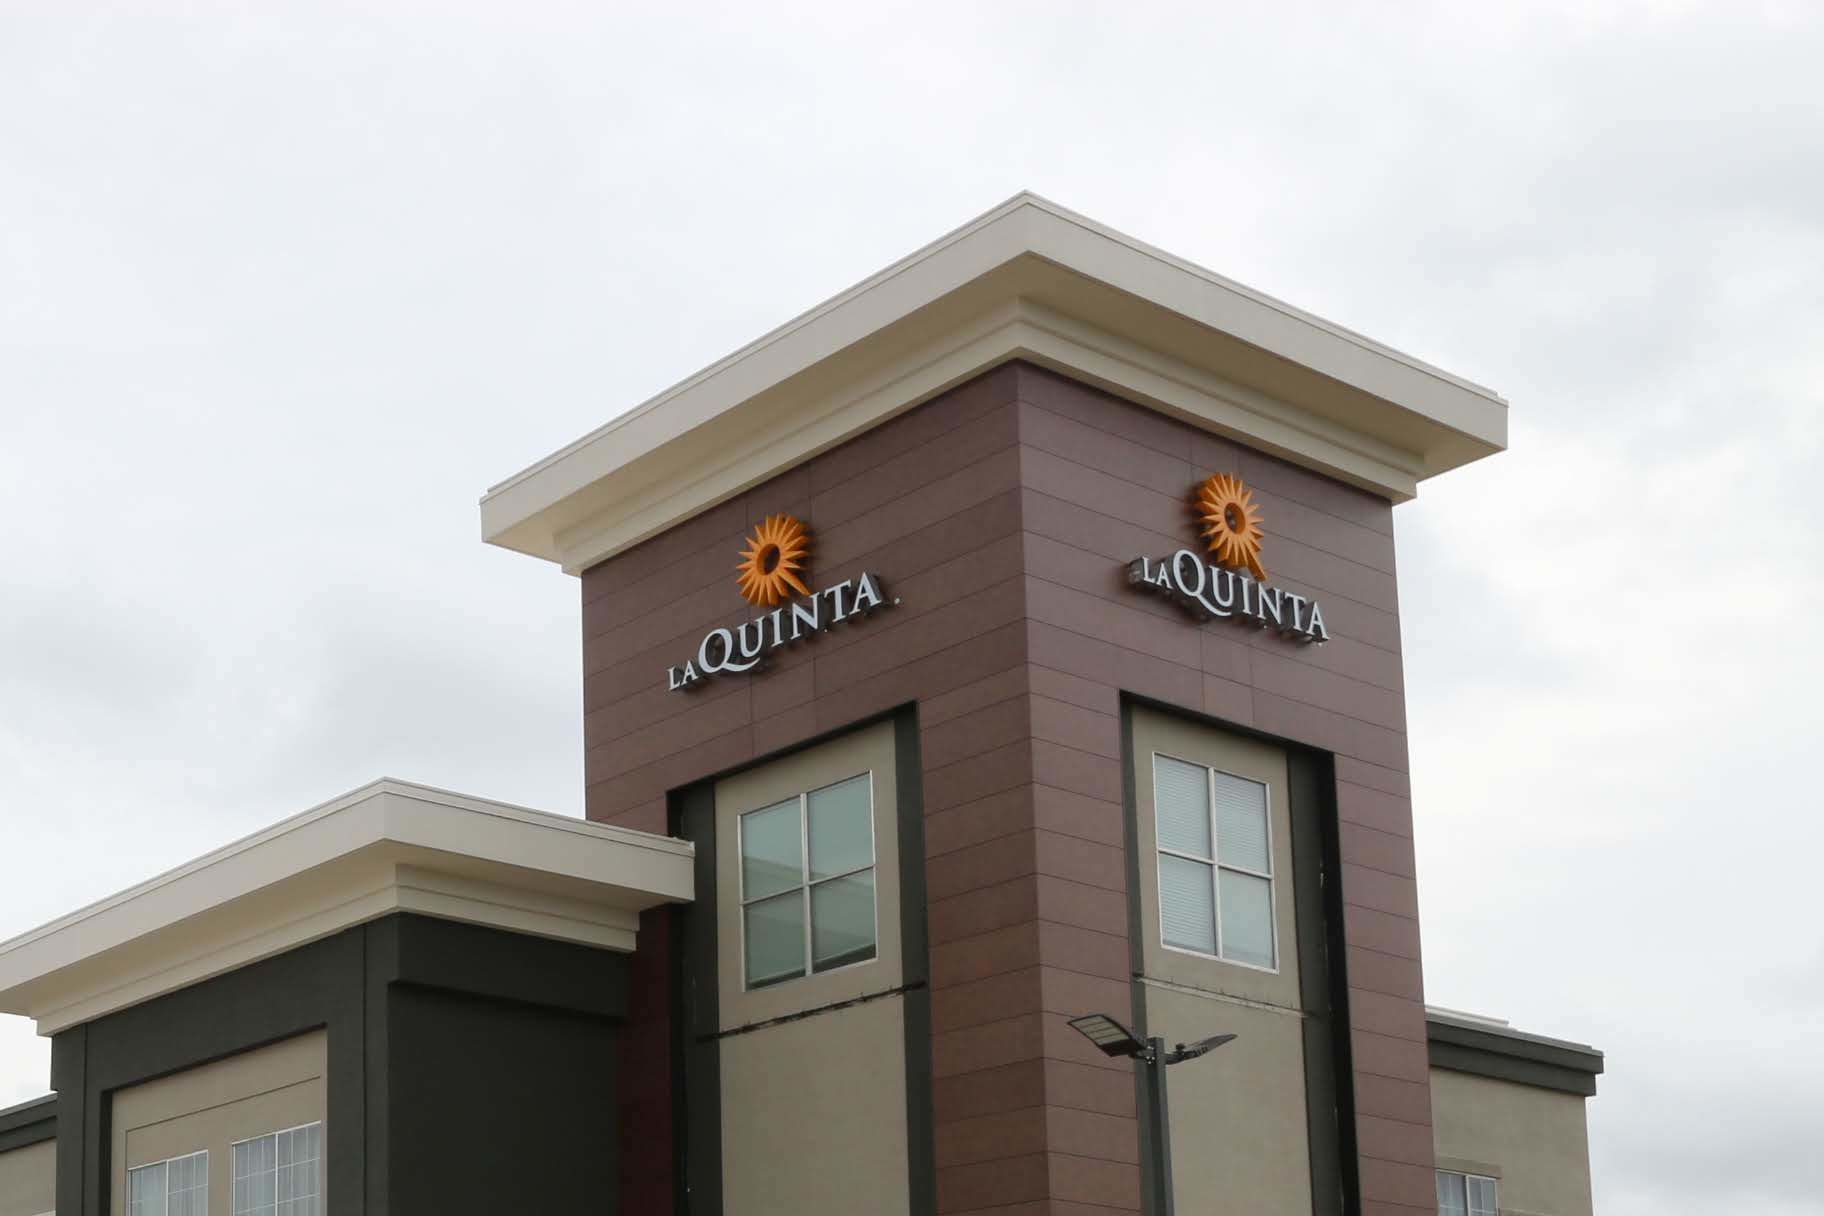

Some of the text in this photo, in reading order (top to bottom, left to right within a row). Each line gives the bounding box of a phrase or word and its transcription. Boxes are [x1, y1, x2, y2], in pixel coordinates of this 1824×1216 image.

[667, 572, 881, 690] LA QUINTA
[1143, 549, 1330, 640] LA QUINTA
